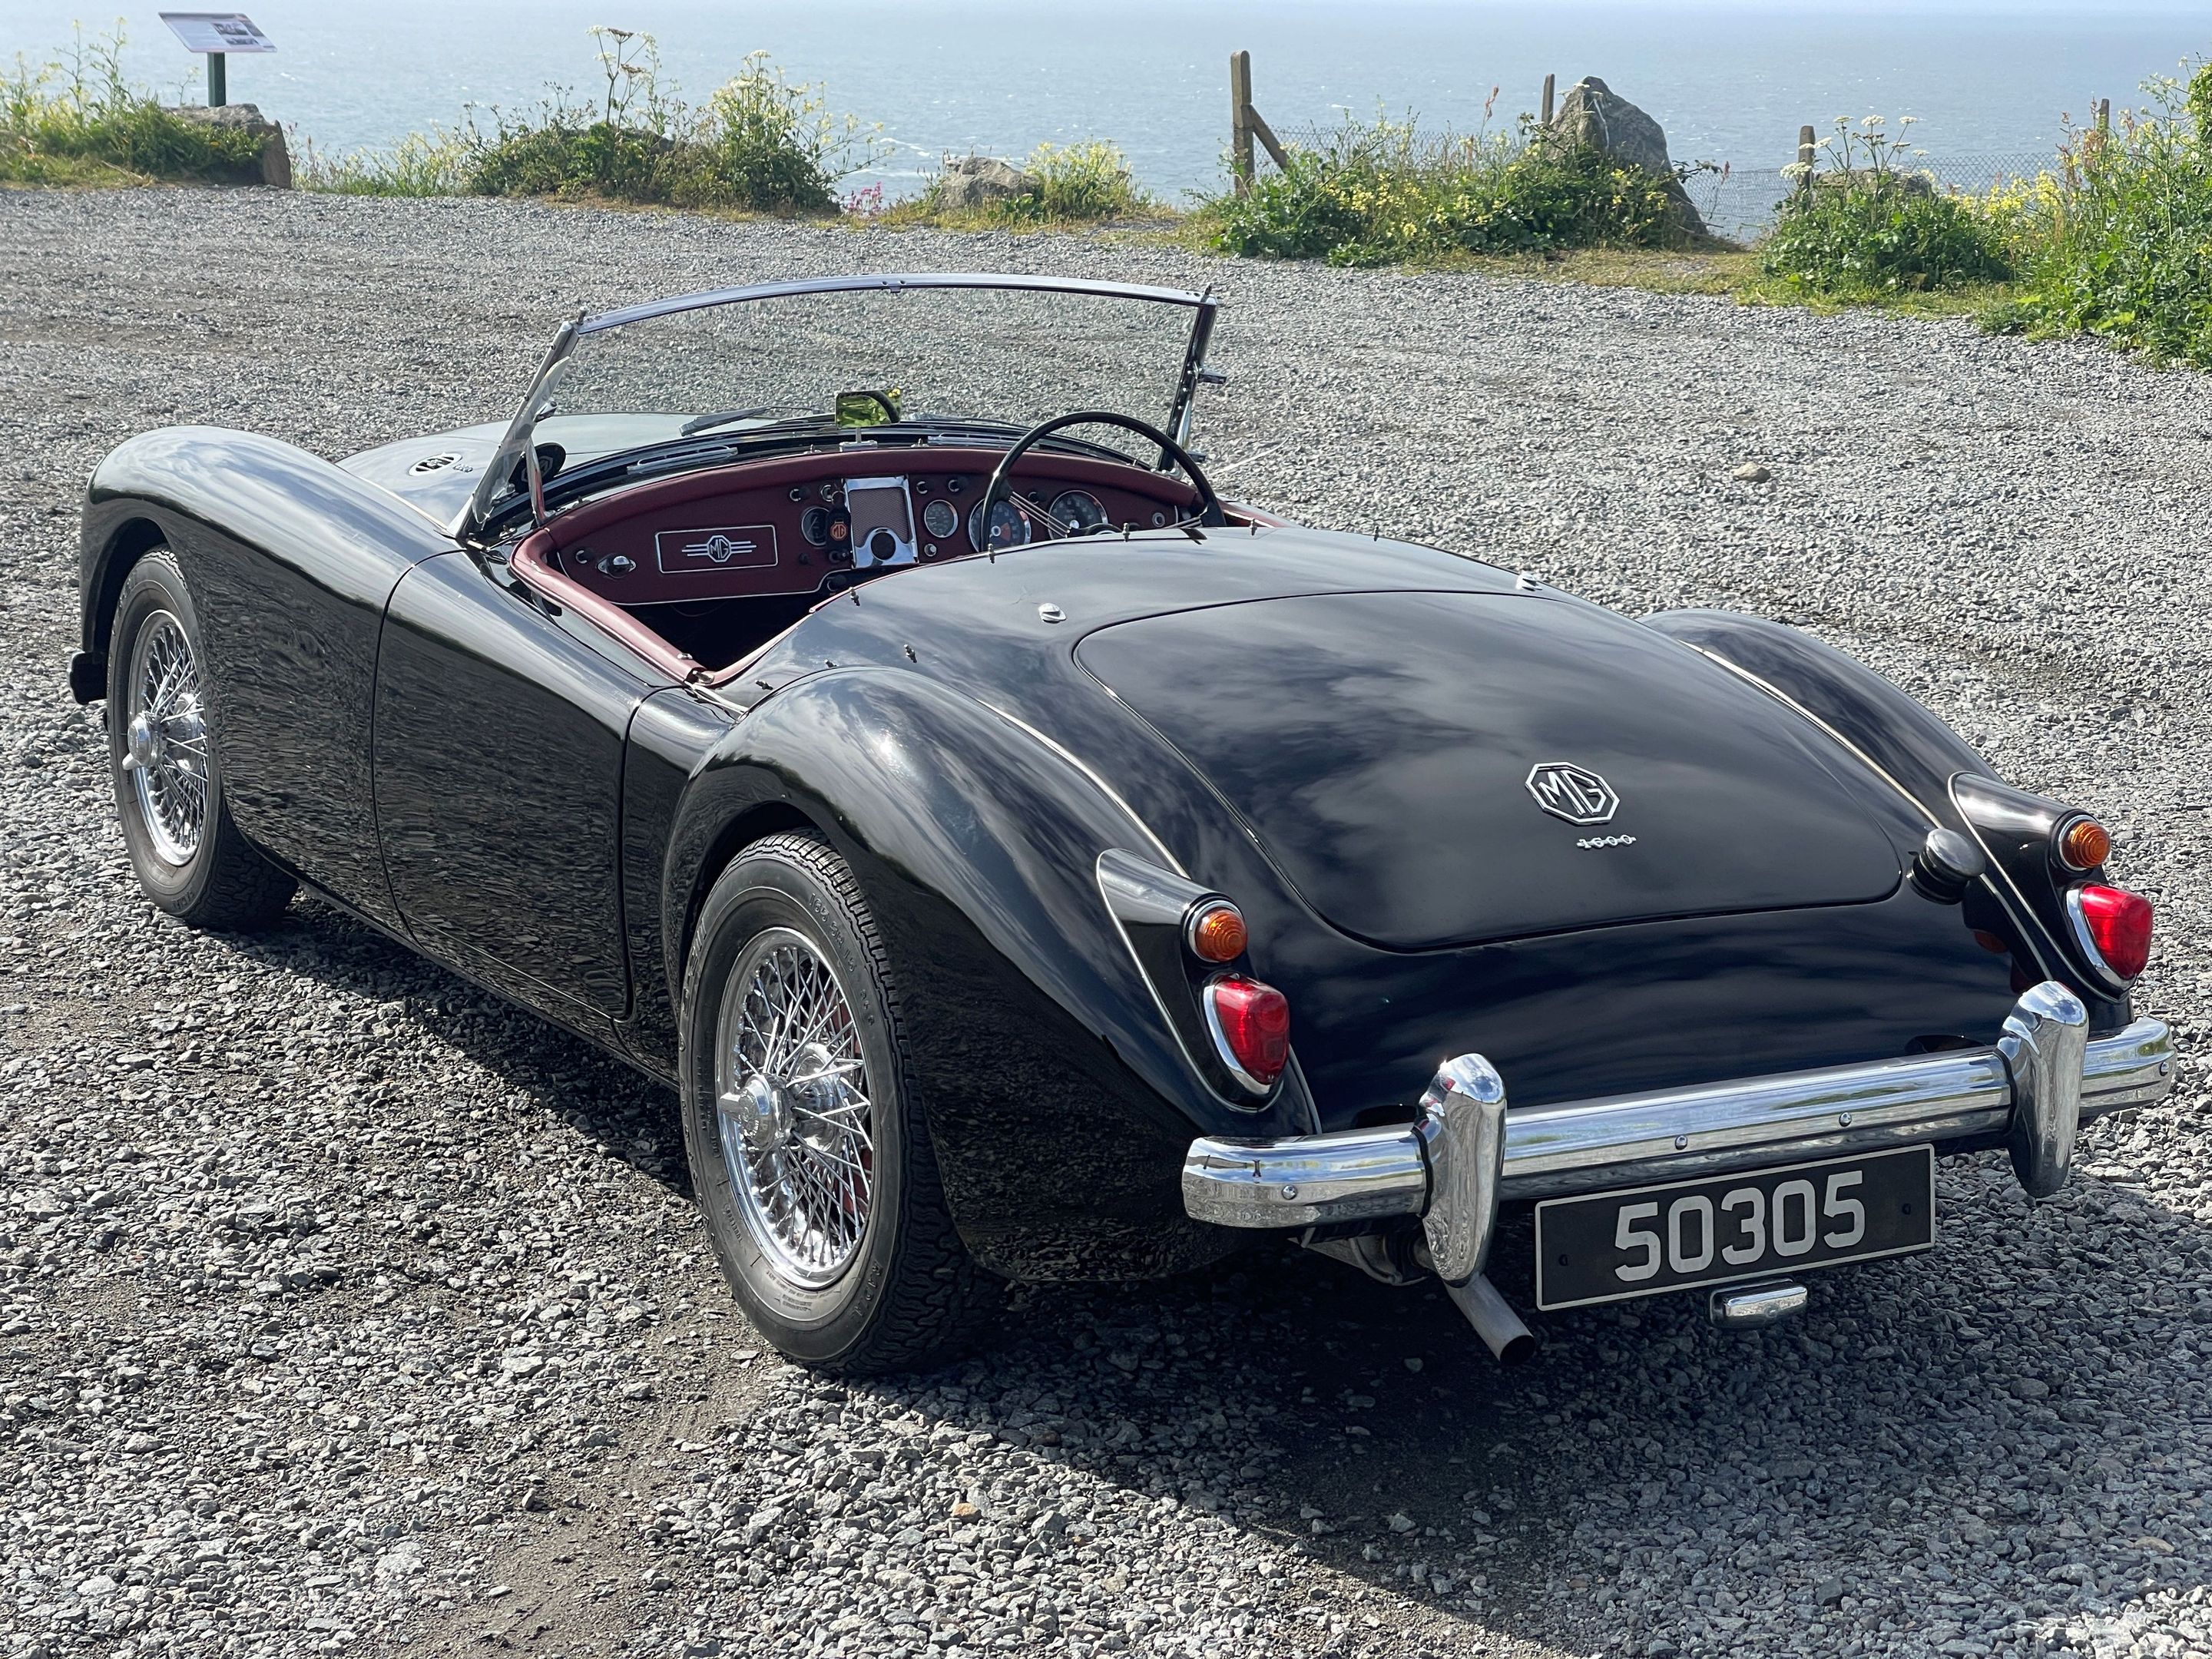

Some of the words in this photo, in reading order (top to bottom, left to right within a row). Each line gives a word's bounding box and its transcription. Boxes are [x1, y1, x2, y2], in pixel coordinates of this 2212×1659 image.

[709, 538, 729, 559] MG
[1537, 769, 1608, 816] MG
[1578, 835, 1634, 848] 1600
[1614, 1170, 1866, 1282] 50305
